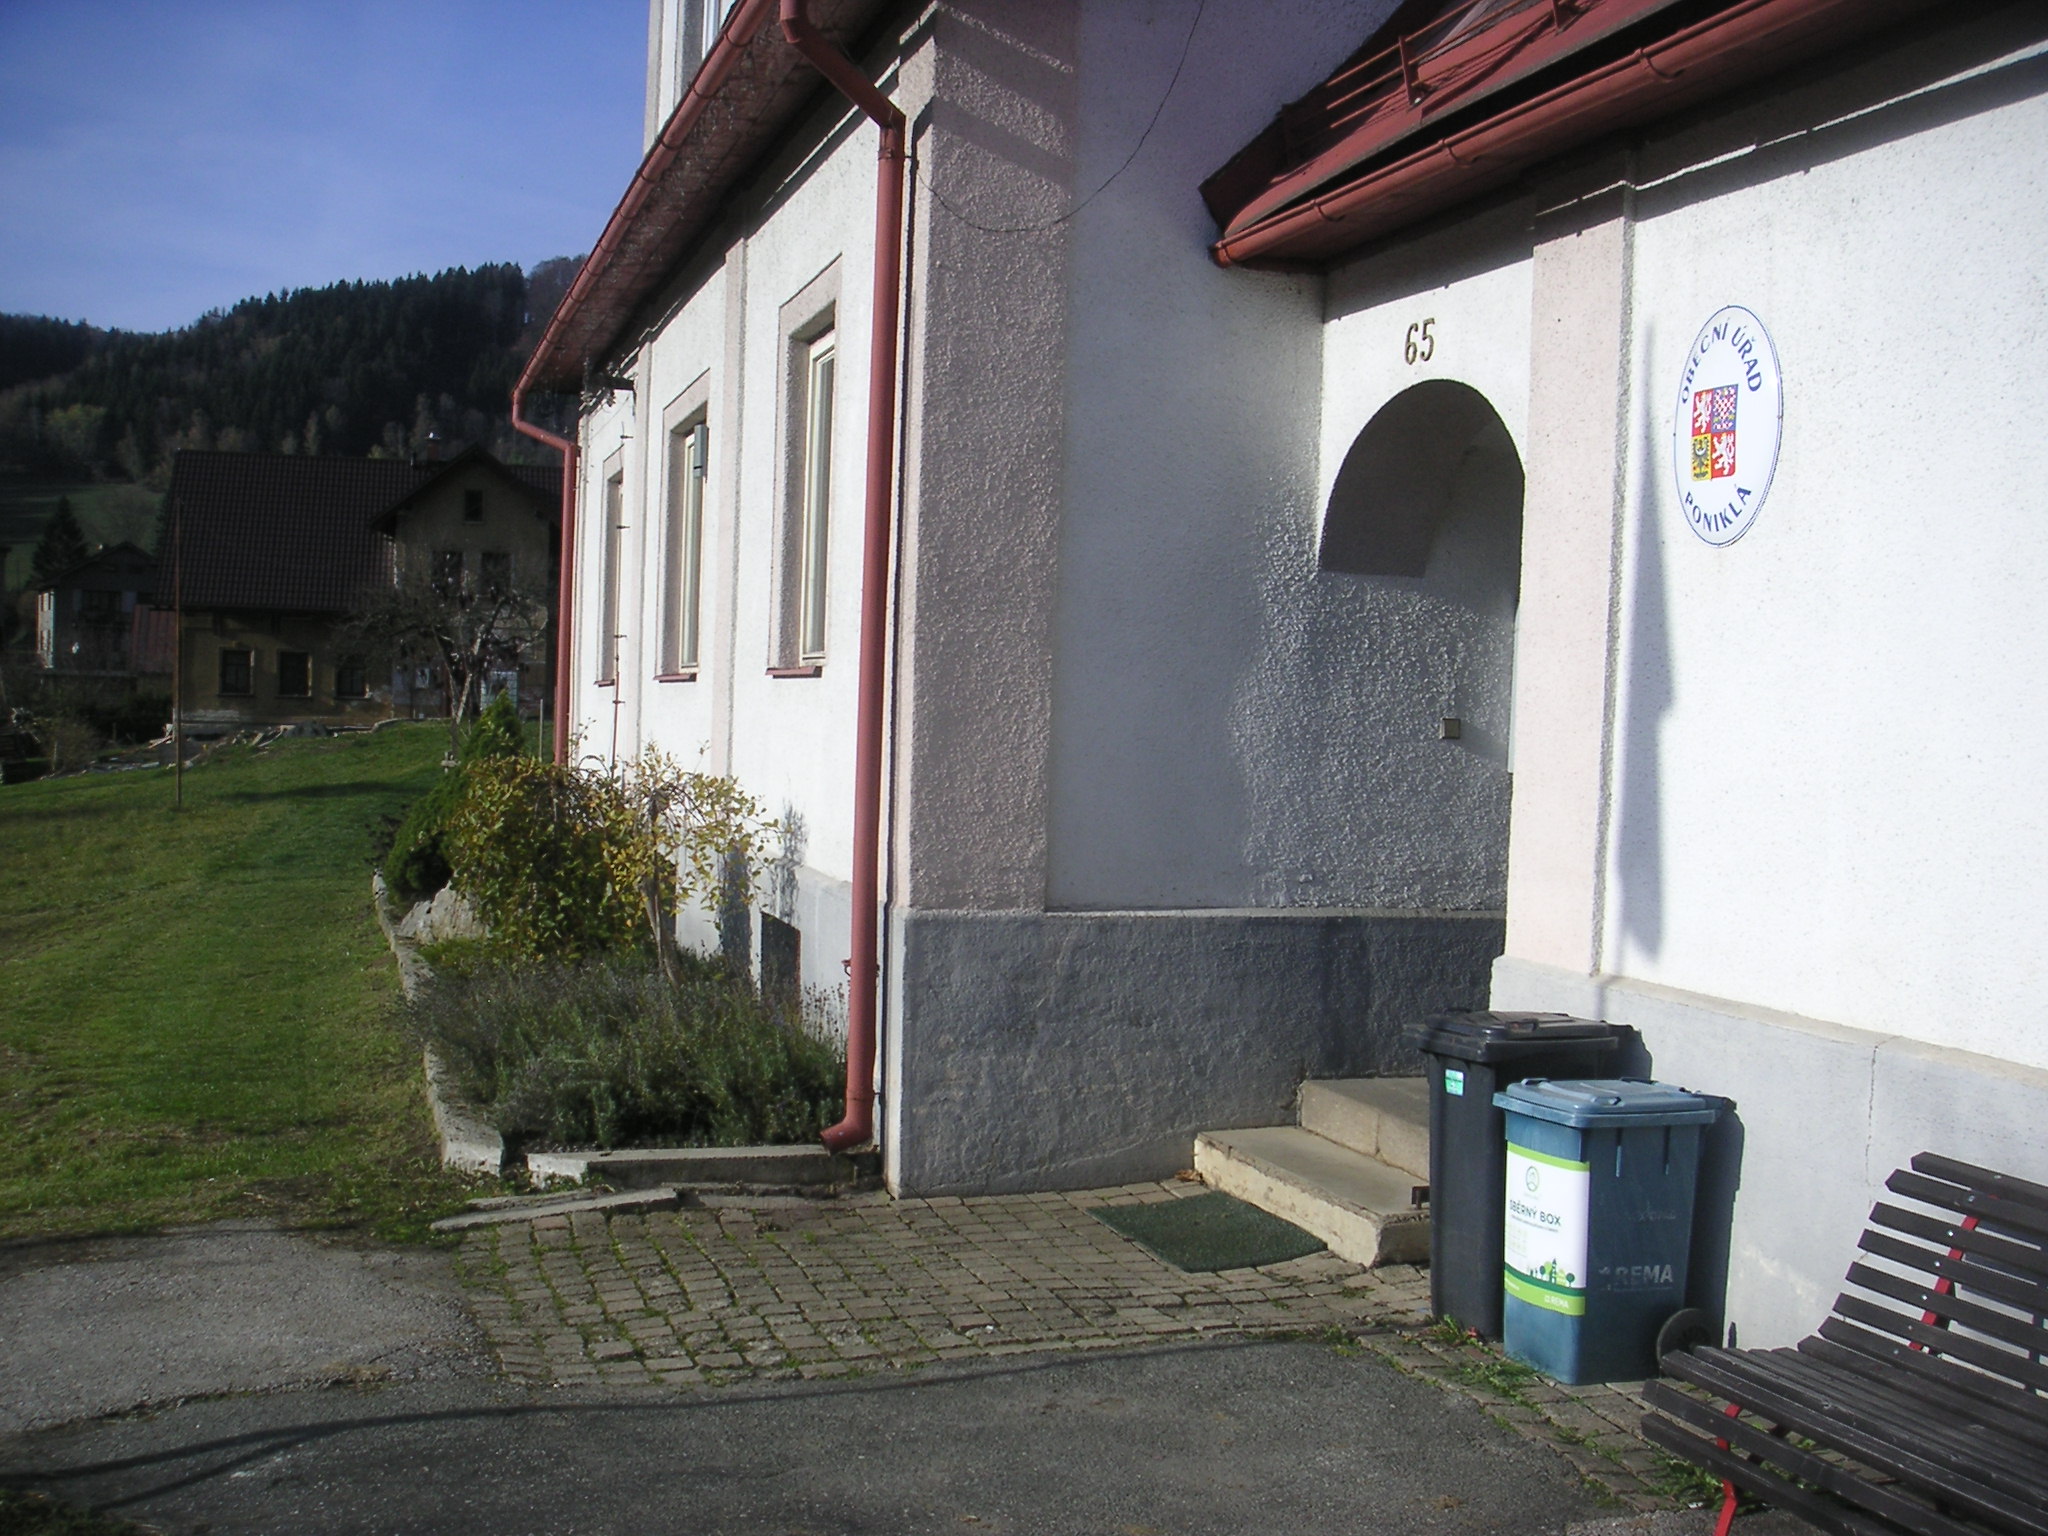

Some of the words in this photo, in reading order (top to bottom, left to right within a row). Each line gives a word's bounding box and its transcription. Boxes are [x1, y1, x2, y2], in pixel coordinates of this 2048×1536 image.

[1404, 317, 1435, 365] 65
[1681, 317, 1729, 404] OBECNÍ
[1731, 325, 1762, 392] ÚŘAD
[1685, 483, 1752, 532] PONIKLÁ
[1540, 1211, 1561, 1227] BOX
